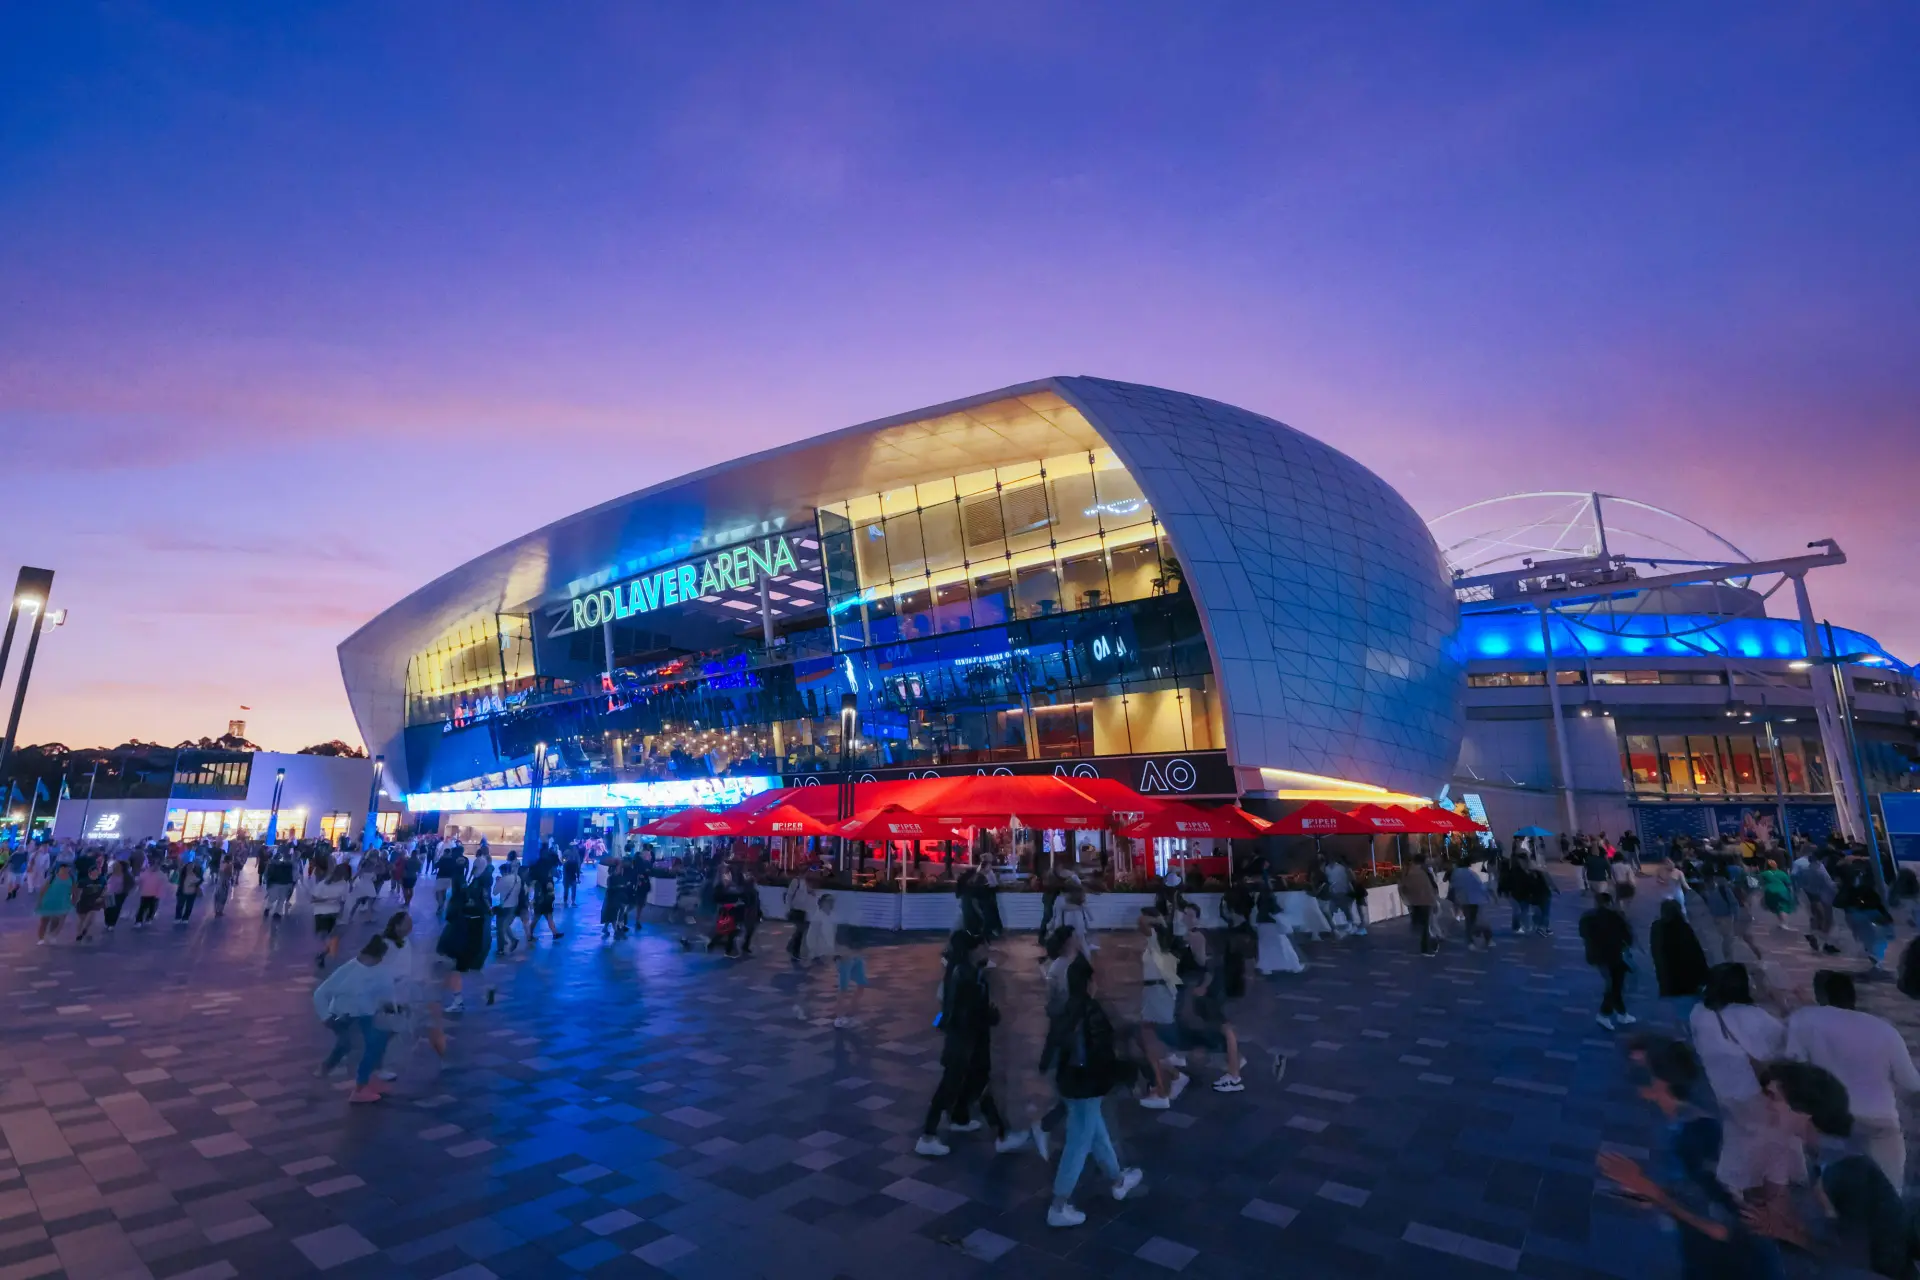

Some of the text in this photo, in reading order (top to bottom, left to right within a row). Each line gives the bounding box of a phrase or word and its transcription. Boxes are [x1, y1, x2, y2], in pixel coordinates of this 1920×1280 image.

[573, 536, 798, 630] ROD LAVER ARENA
[1139, 758, 1197, 791] AO
